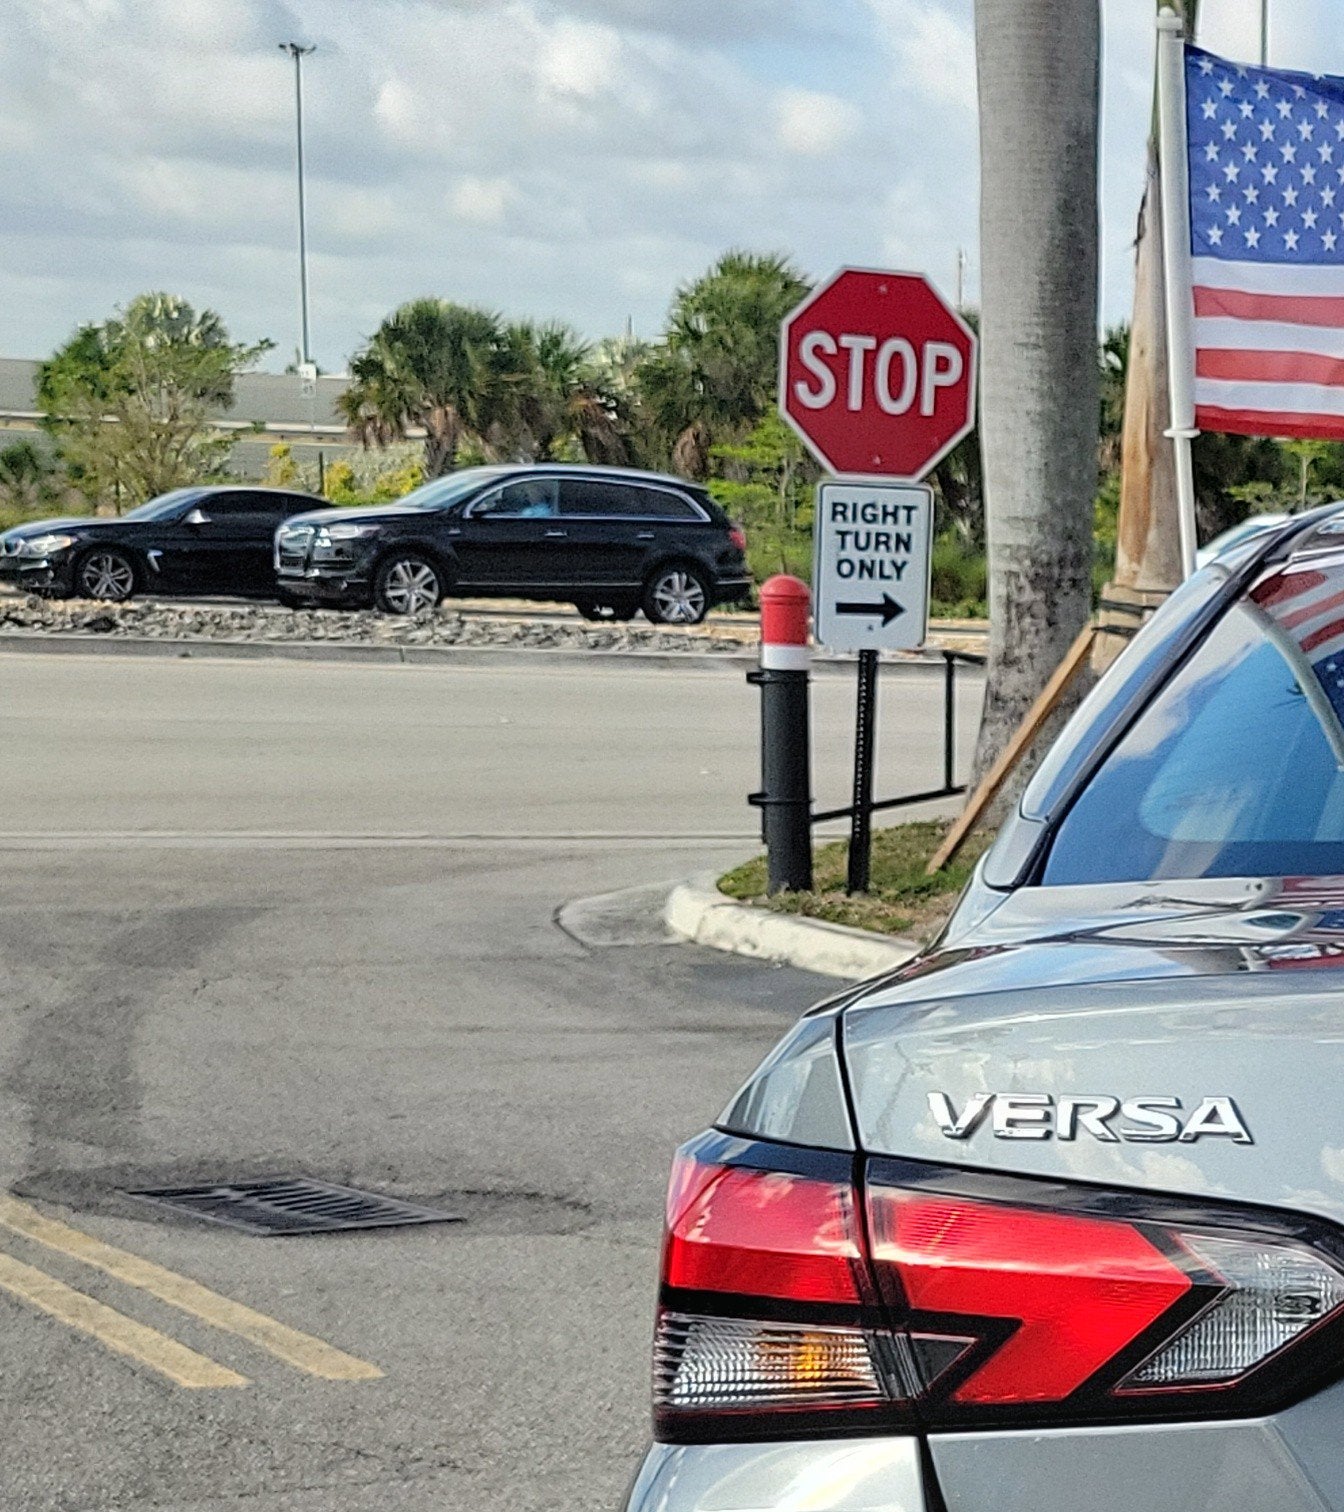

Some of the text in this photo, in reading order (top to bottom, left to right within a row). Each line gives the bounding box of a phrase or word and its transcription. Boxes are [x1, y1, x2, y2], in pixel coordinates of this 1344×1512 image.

[795, 330, 963, 417] STOP
[831, 501, 918, 526] RIGHT
[835, 530, 913, 554] TURN
[836, 558, 908, 583] ONLY
[925, 1091, 1255, 1145] VERSA
